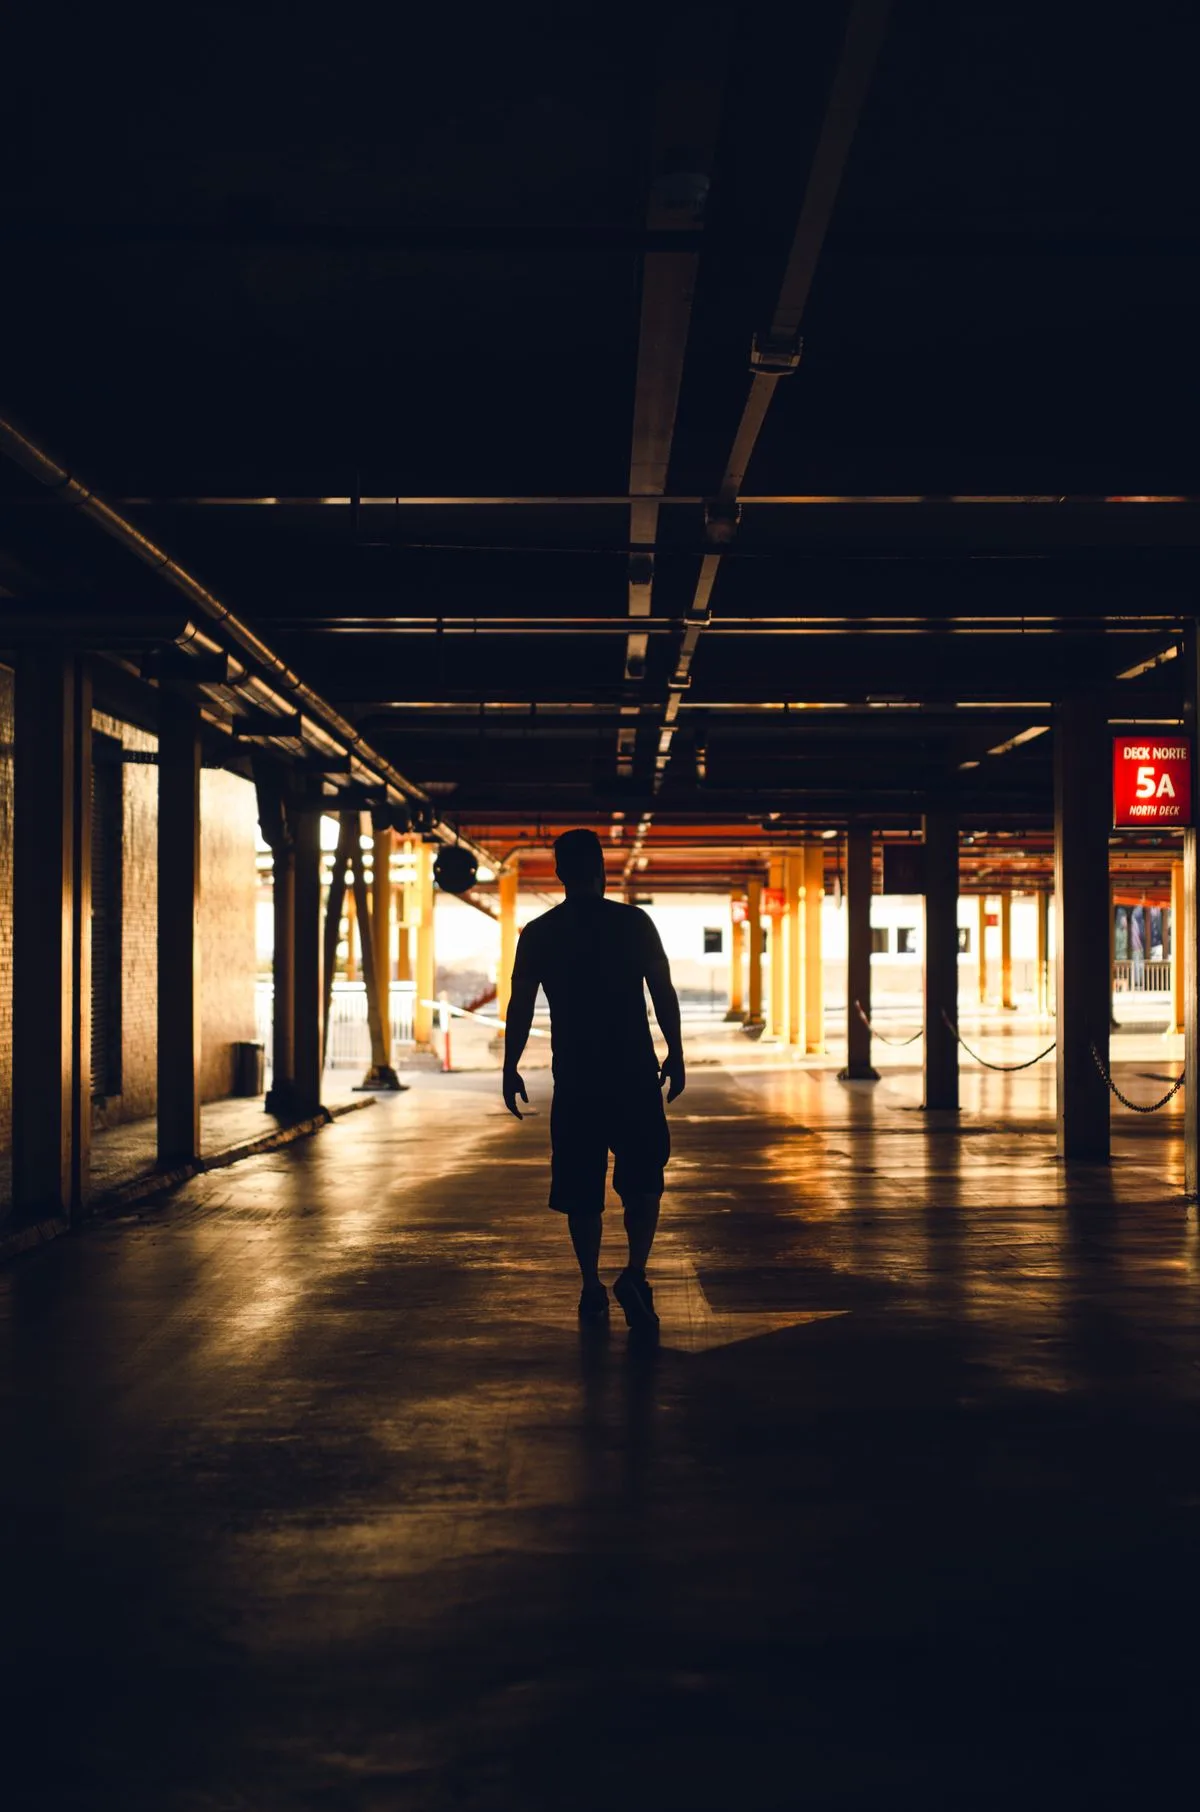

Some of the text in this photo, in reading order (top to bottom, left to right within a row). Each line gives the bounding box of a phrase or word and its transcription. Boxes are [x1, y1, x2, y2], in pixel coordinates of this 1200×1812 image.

[1123, 747, 1187, 760] DECK NORTE
[1136, 766, 1175, 798] 5A
[1129, 805, 1180, 816] NORTH DECK
